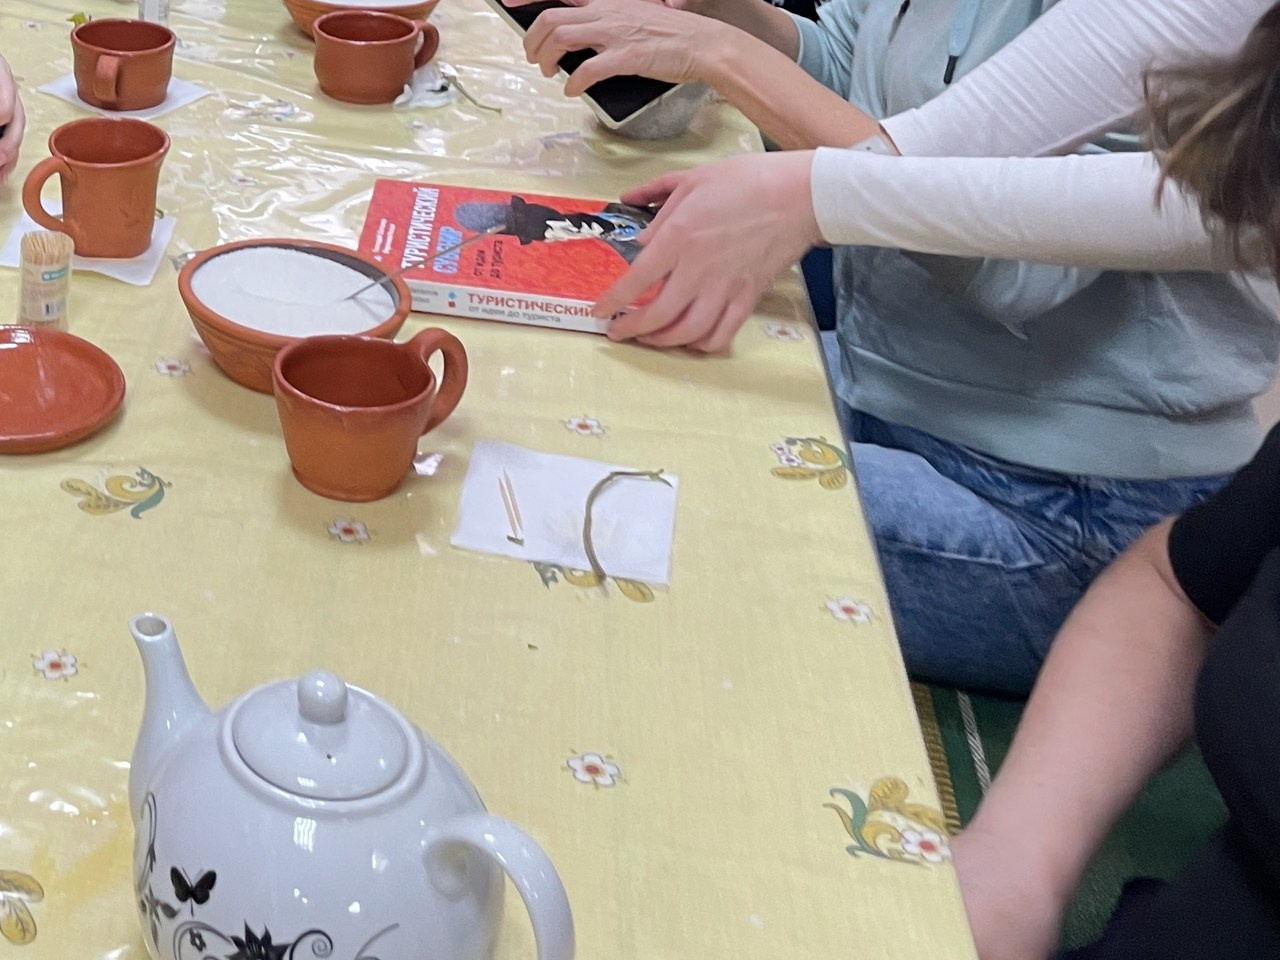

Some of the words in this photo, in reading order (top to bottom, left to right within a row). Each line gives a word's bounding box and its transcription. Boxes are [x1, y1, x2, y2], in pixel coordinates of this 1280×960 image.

[401, 187, 439, 269] ТУРИСТИЧЕСКИЙ
[468, 305, 480, 314] от
[507, 309, 520, 319] до
[522, 311, 561, 323] туриста
